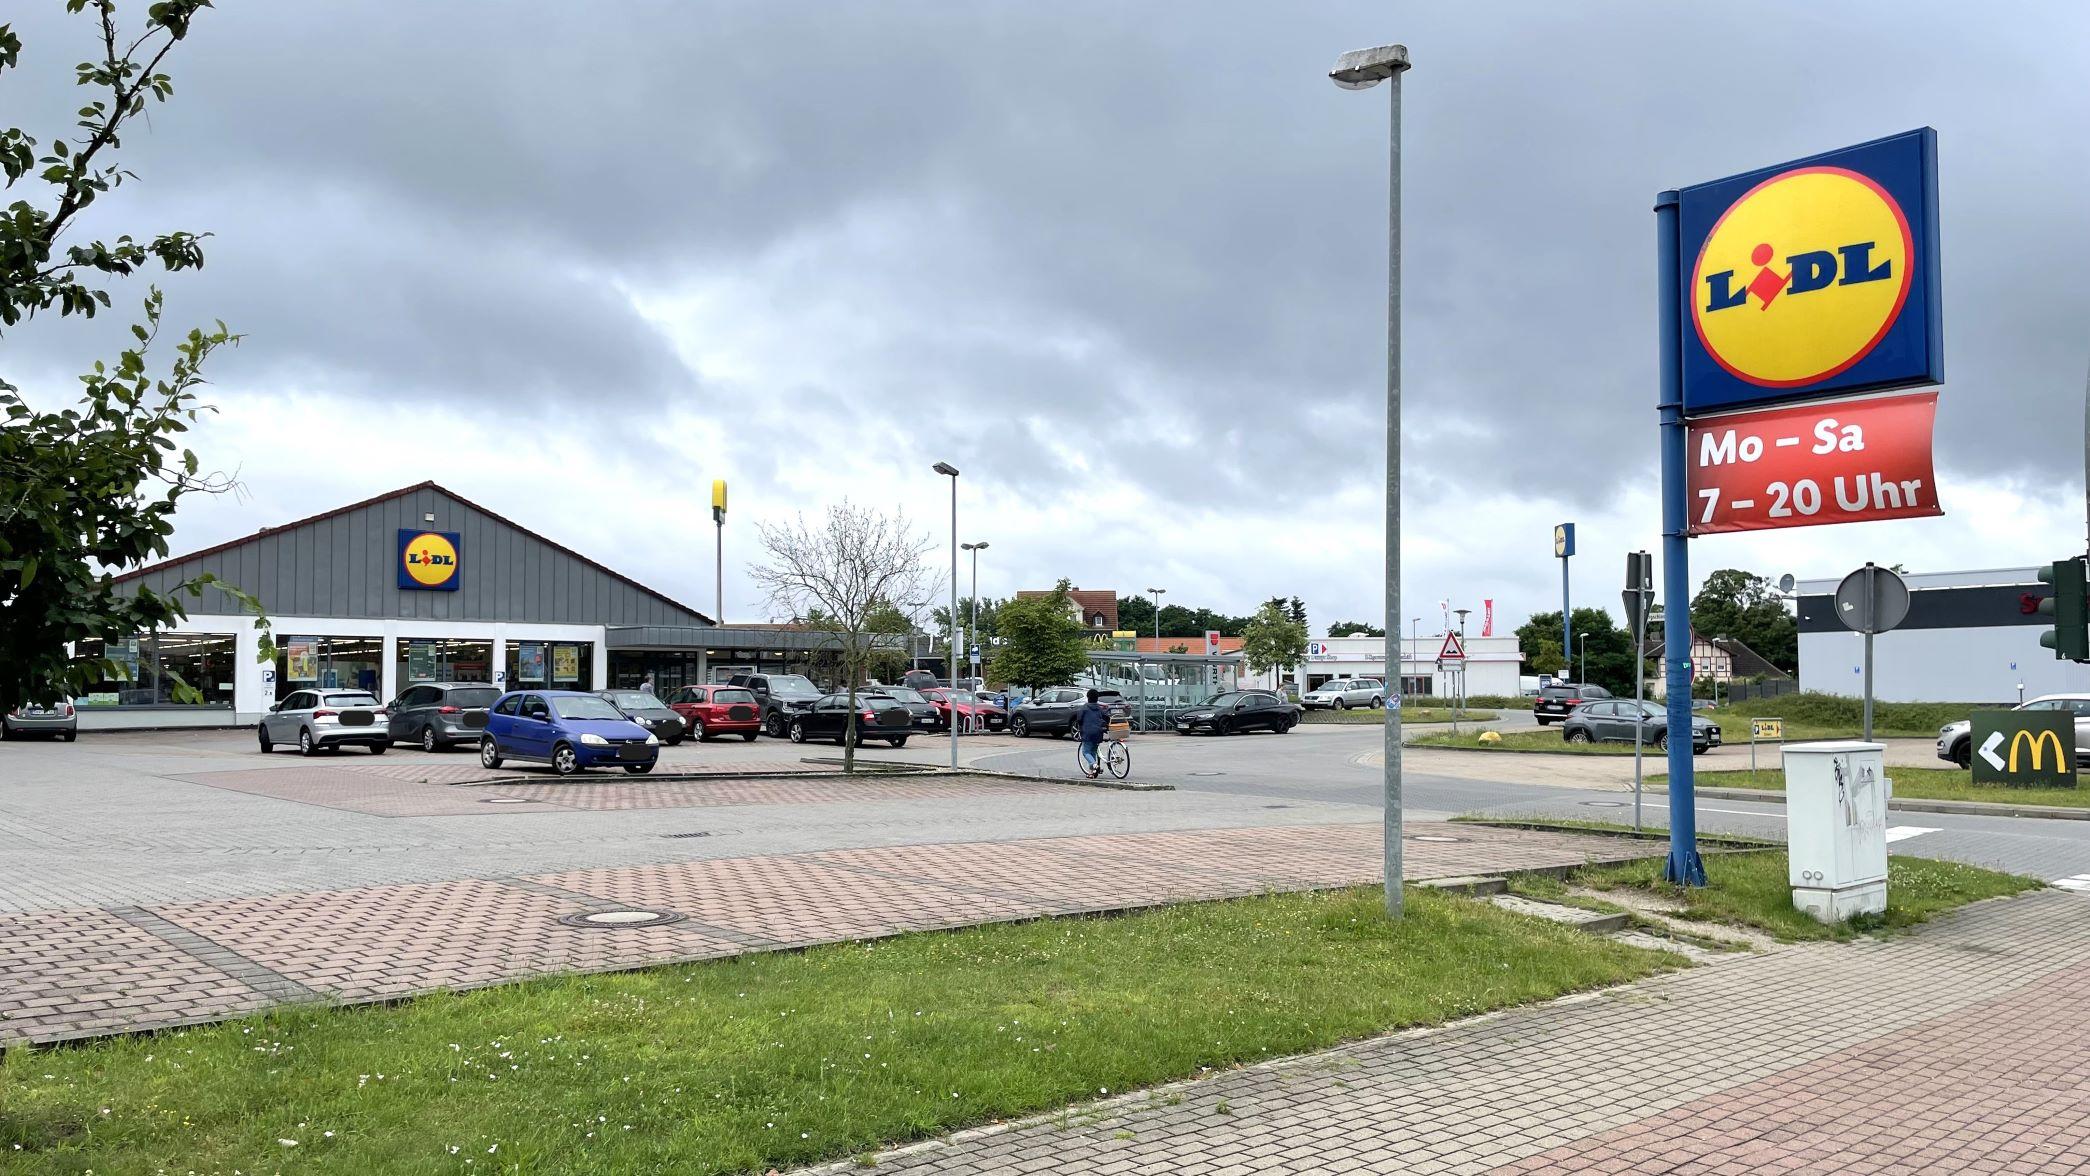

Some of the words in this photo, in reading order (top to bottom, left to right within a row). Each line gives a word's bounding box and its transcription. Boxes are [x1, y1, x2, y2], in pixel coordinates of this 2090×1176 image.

[1699, 430, 1764, 467] Mo
[1811, 418, 1865, 455] Sa
[1699, 487, 1721, 524] 7
[1765, 479, 1822, 518] 20
[1833, 472, 1922, 513] Uhr
